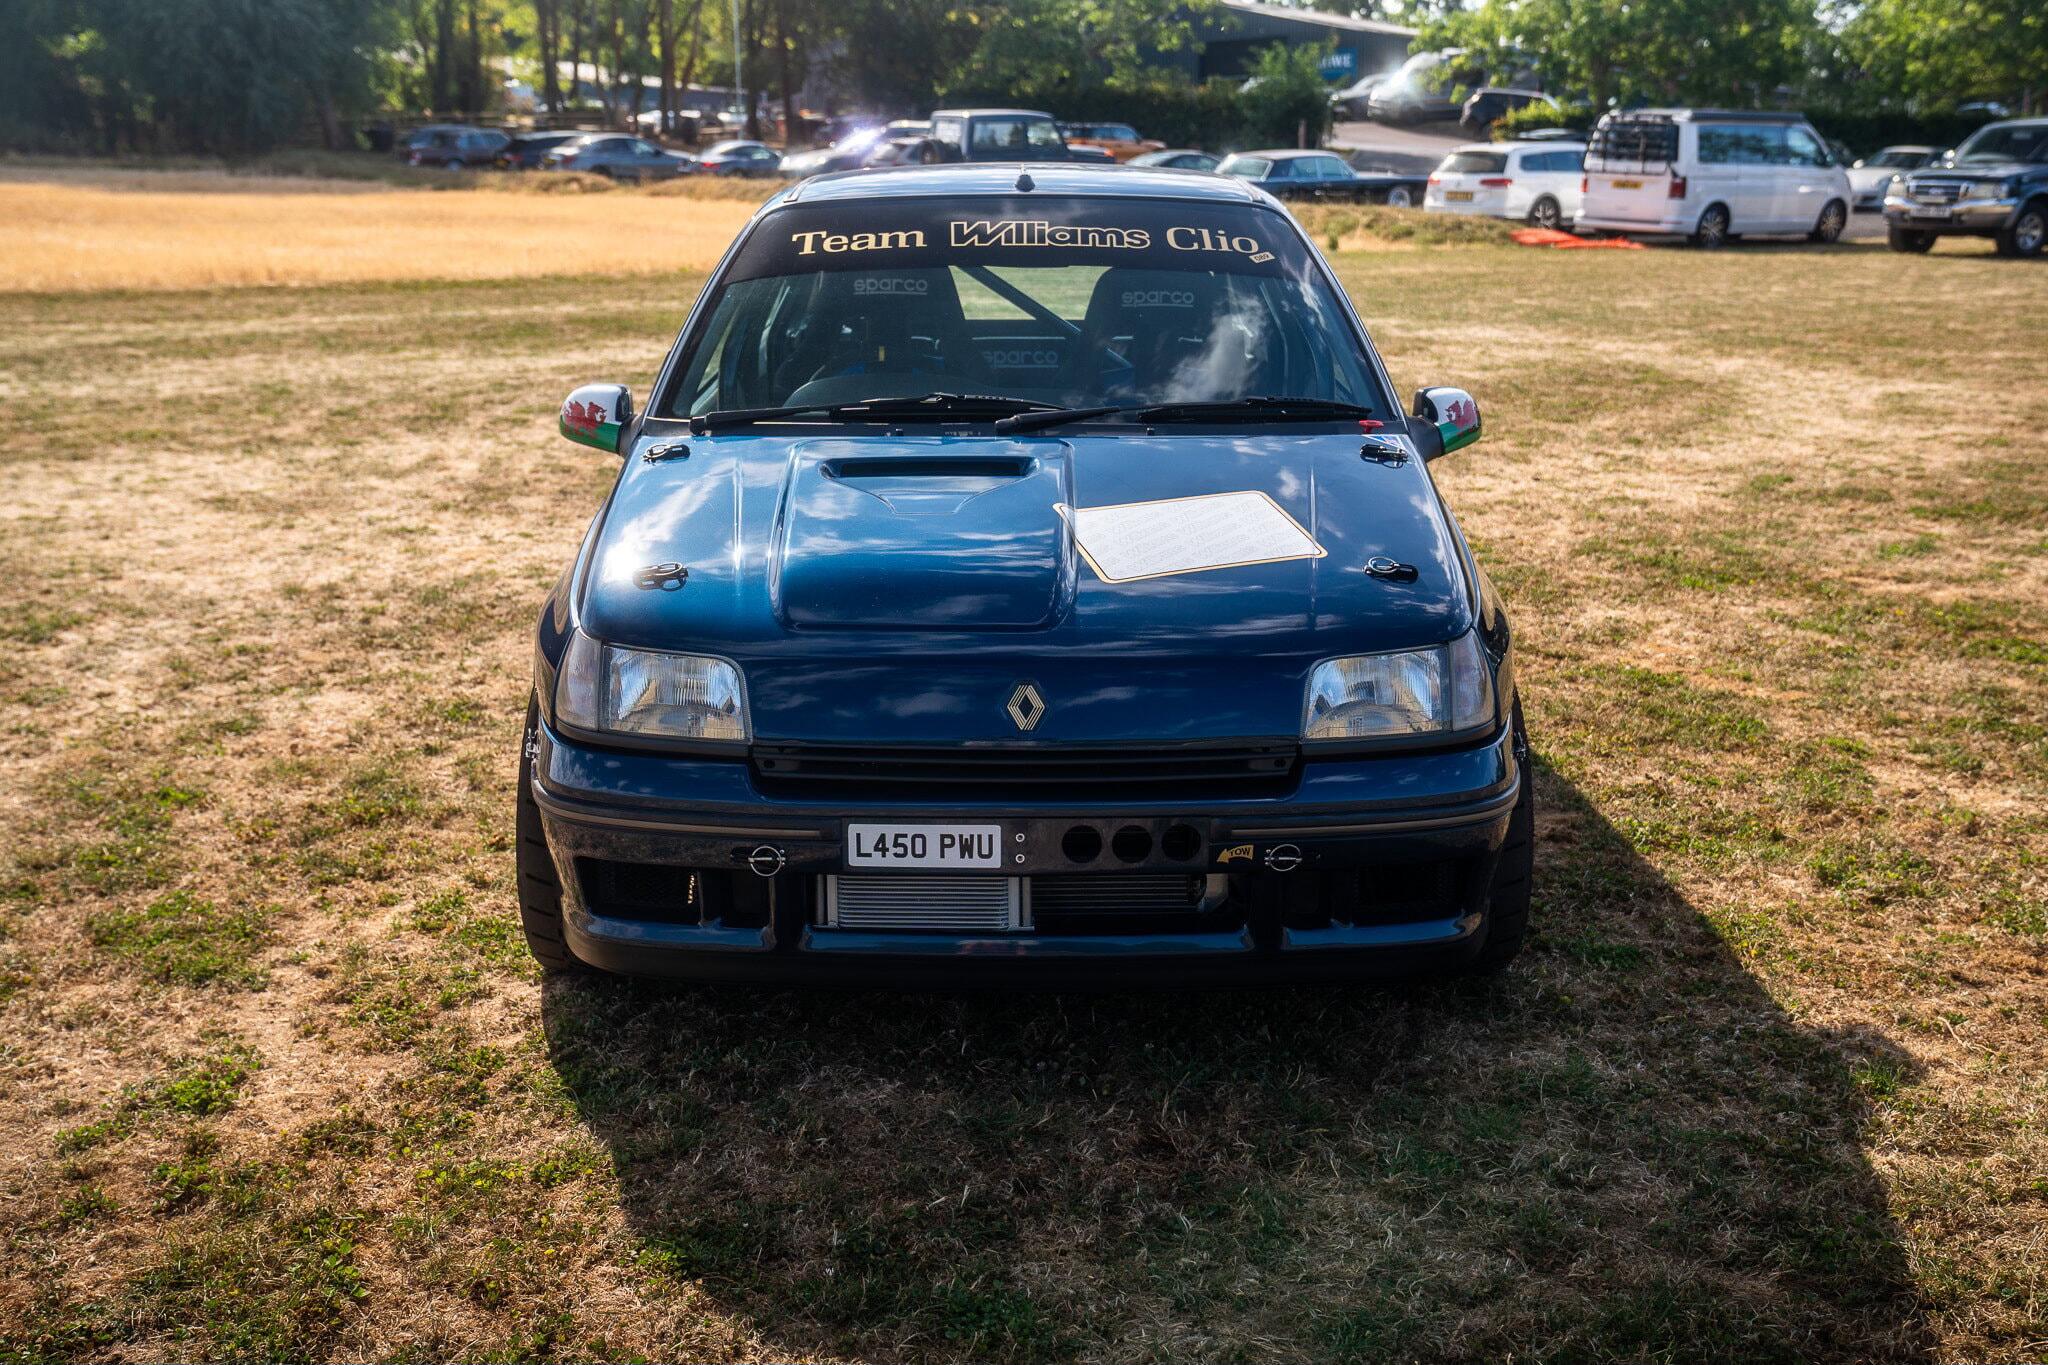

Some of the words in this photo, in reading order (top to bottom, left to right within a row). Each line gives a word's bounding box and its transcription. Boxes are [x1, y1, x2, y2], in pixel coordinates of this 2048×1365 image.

[792, 228, 927, 255] Team
[950, 220, 1151, 249] Williams
[1166, 226, 1260, 254] Clio
[853, 278, 928, 296] sparco
[1121, 291, 1194, 307] sparco
[983, 350, 1058, 368] sparco
[856, 832, 927, 859] L450
[939, 832, 994, 859] PWU
[1228, 846, 1251, 857] TOW
